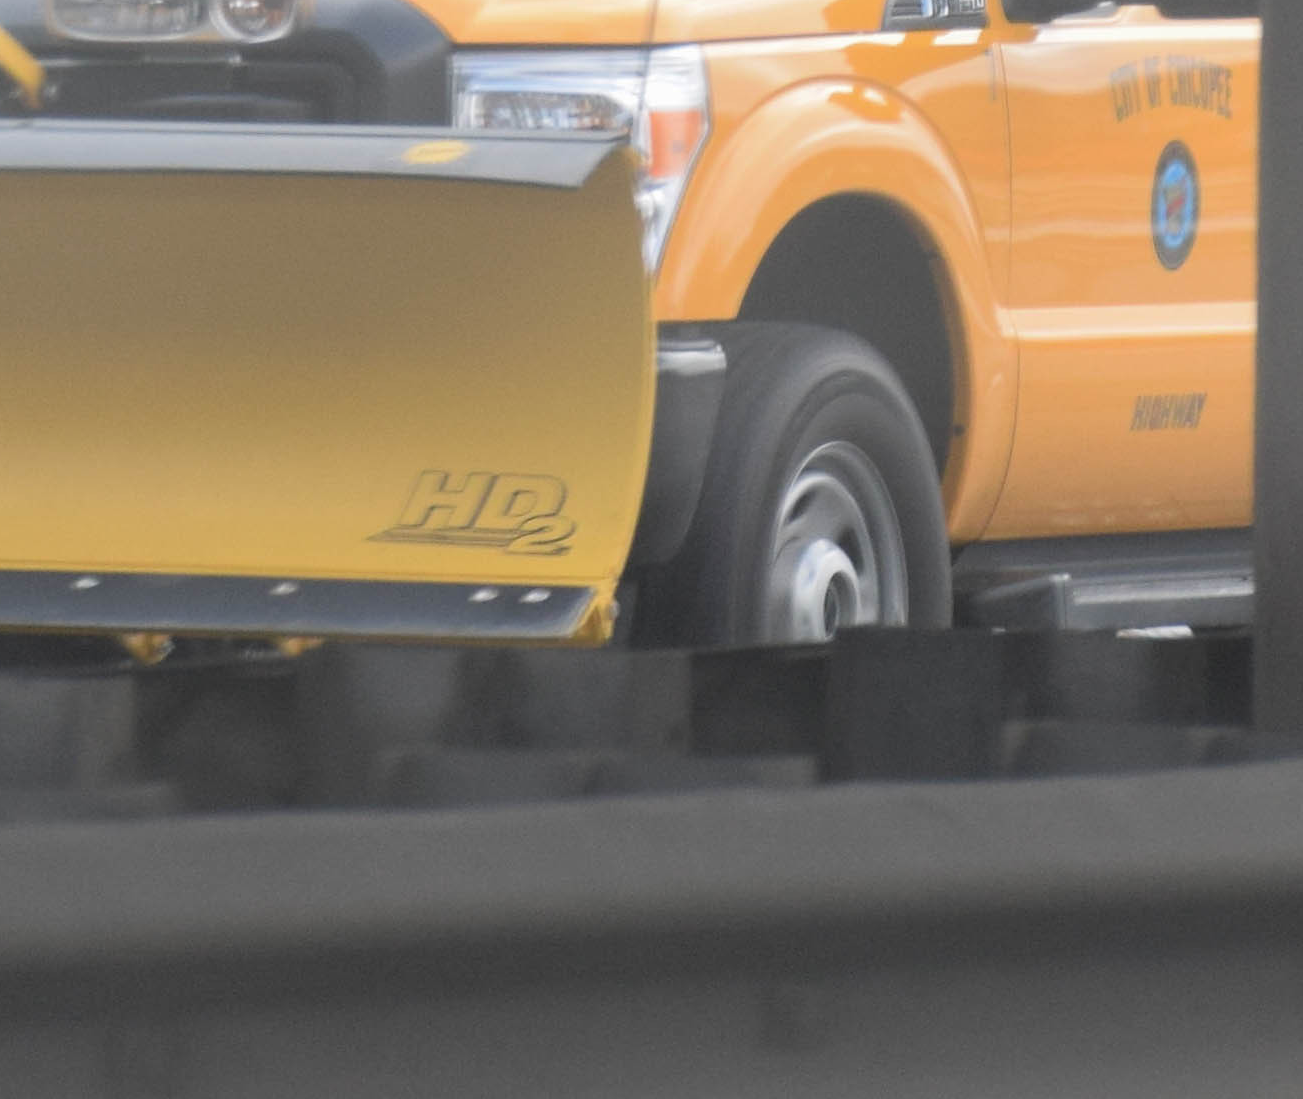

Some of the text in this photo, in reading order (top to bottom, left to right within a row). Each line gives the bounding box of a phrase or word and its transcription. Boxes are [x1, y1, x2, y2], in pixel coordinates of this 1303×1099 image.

[1109, 62, 1142, 122] CITY
[1144, 54, 1162, 109] OF
[1129, 392, 1207, 430] HIGHWAY
